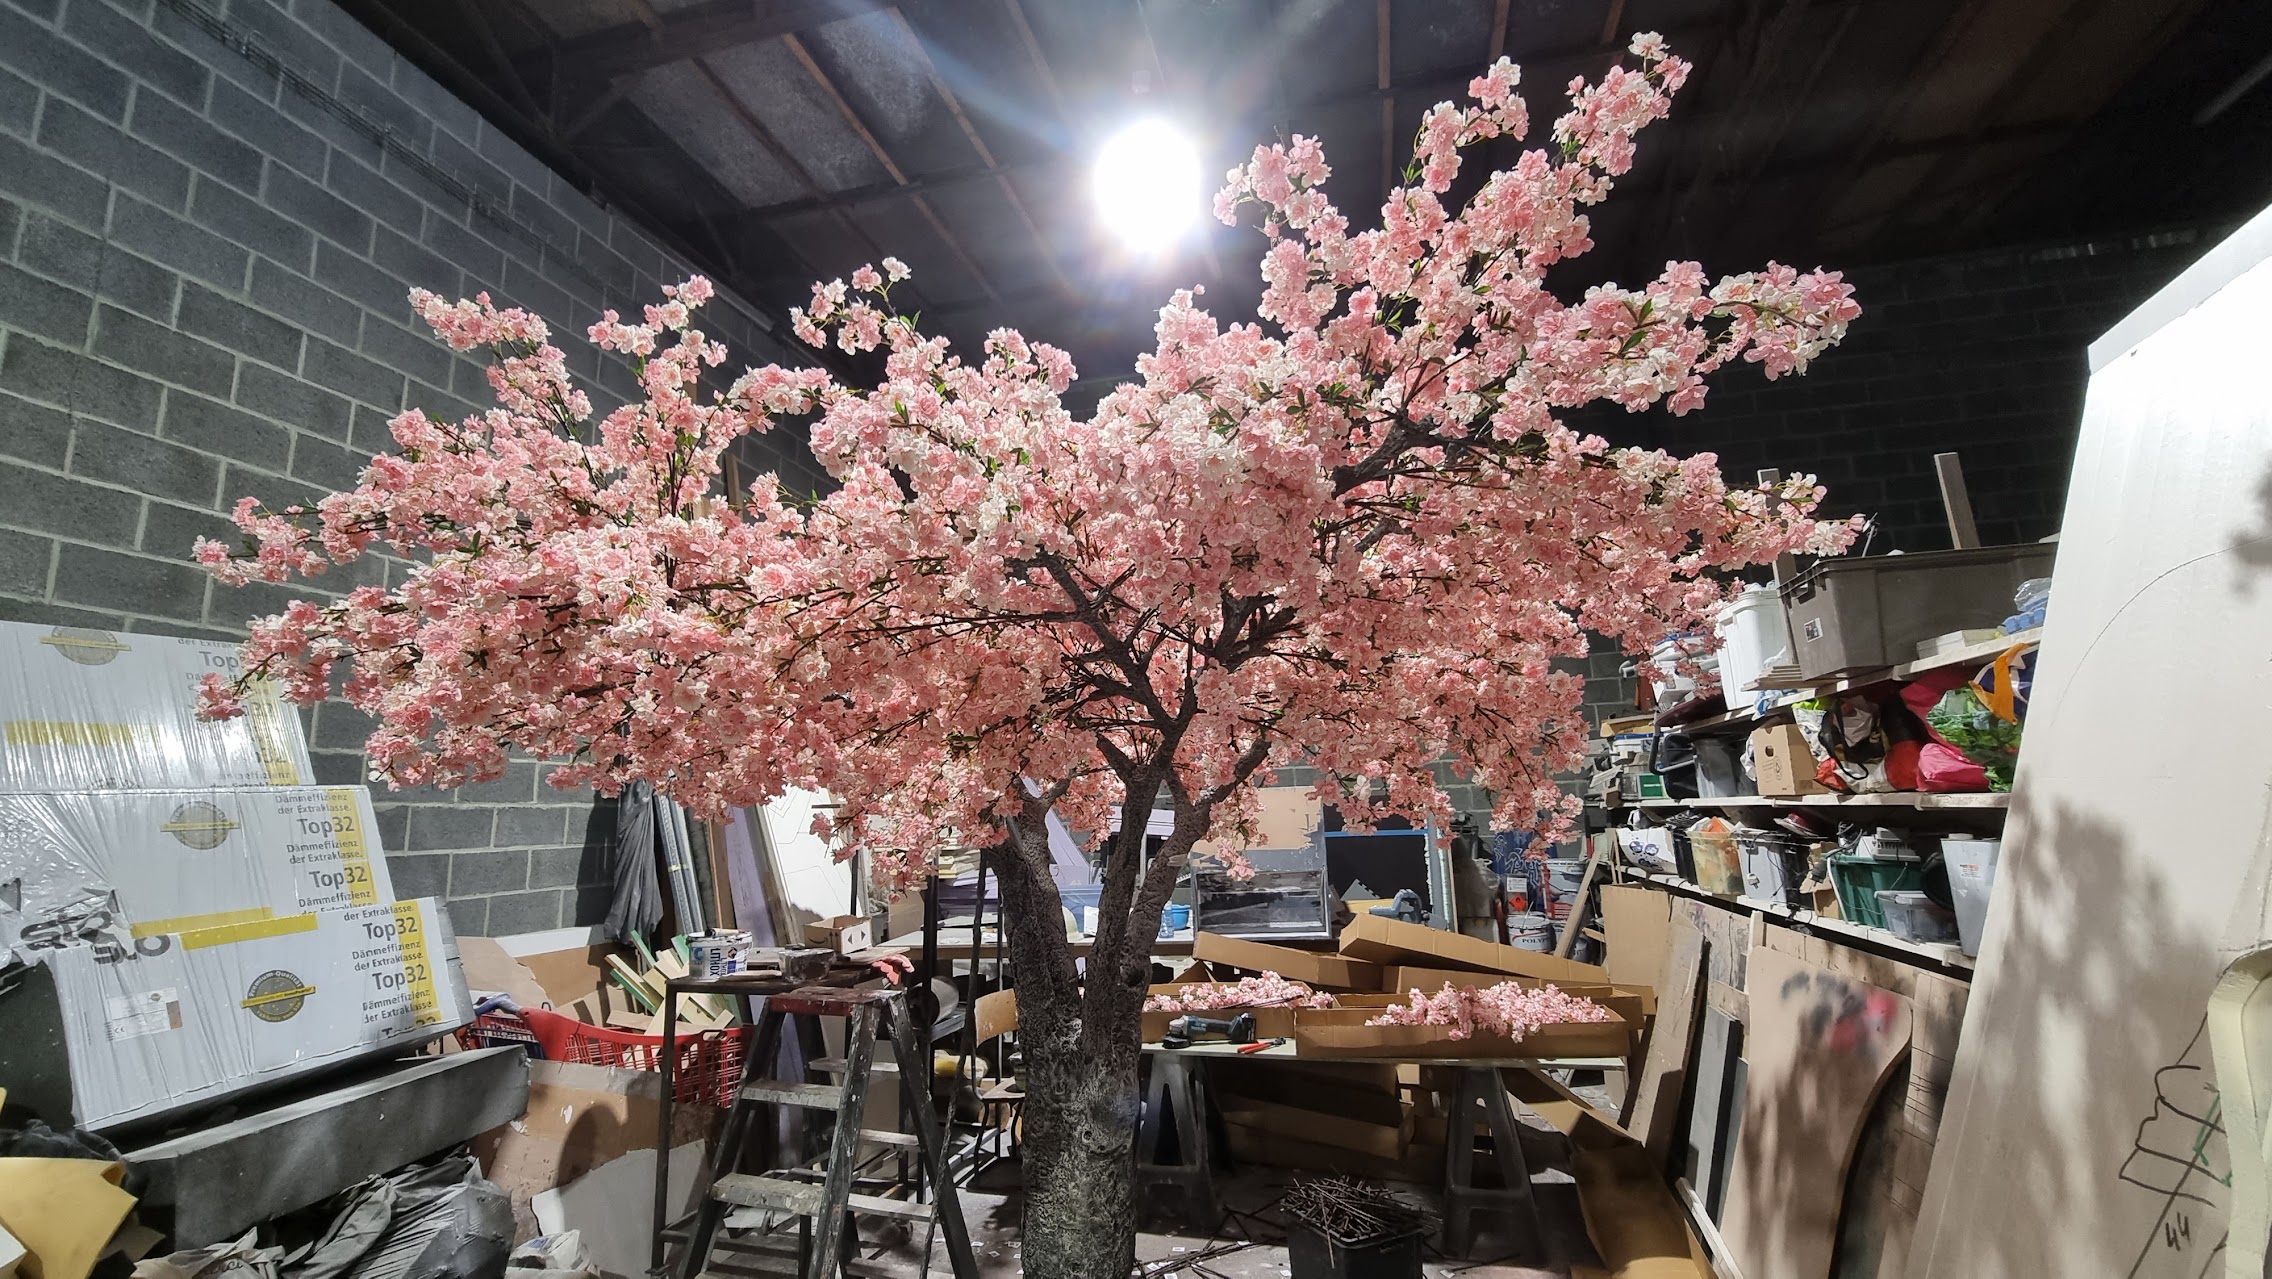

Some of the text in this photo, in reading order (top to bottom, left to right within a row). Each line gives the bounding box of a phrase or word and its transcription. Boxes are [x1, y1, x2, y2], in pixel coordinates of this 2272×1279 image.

[275, 793, 348, 804] Dämmeffizienz
[278, 806, 293, 815] der
[297, 816, 355, 838] Top32
[286, 840, 359, 853] Dämmeffizienz
[289, 856, 306, 865] der
[309, 866, 368, 890] Top32
[298, 890, 371, 908] Dämmeffizienz
[343, 912, 359, 922] der
[362, 916, 418, 941] Top32
[352, 941, 422, 960] Dämmeffizienz
[354, 961, 370, 972] der
[372, 964, 427, 990] Top32
[362, 989, 431, 1011] Dämmeffizienz
[2165, 1211, 2191, 1252] 44
